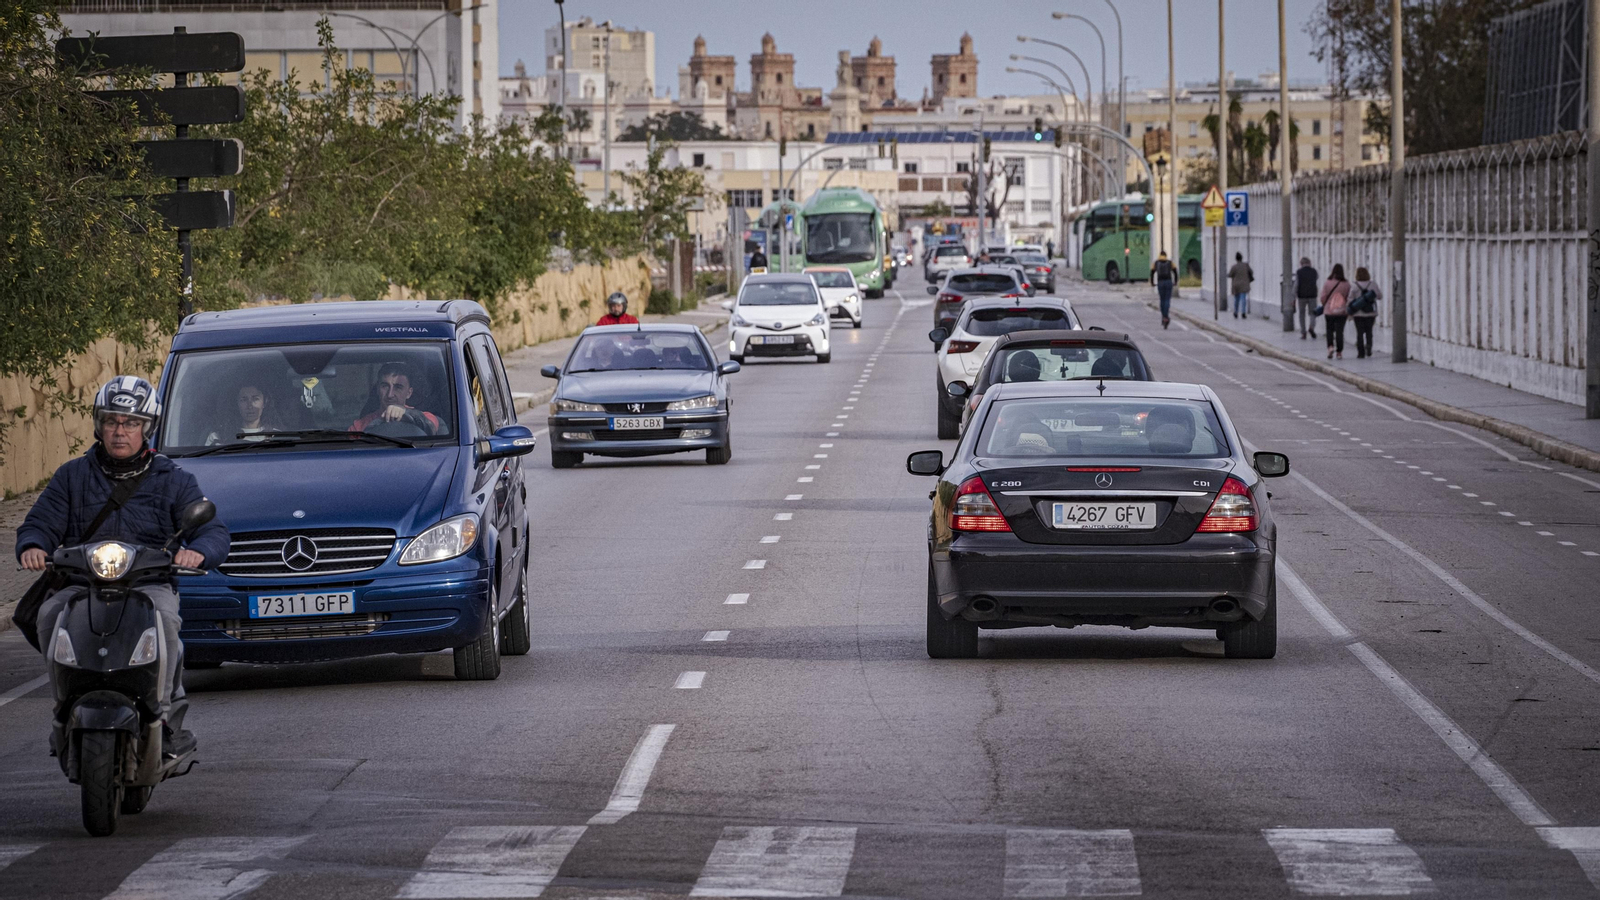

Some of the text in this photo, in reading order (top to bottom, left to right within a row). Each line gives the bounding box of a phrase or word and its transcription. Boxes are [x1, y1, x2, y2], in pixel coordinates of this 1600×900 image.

[616, 418, 661, 429] 5263 CBX
[1066, 506, 1146, 522] 4267 GFV
[262, 596, 306, 615] 7311
[315, 594, 349, 612] GFP
